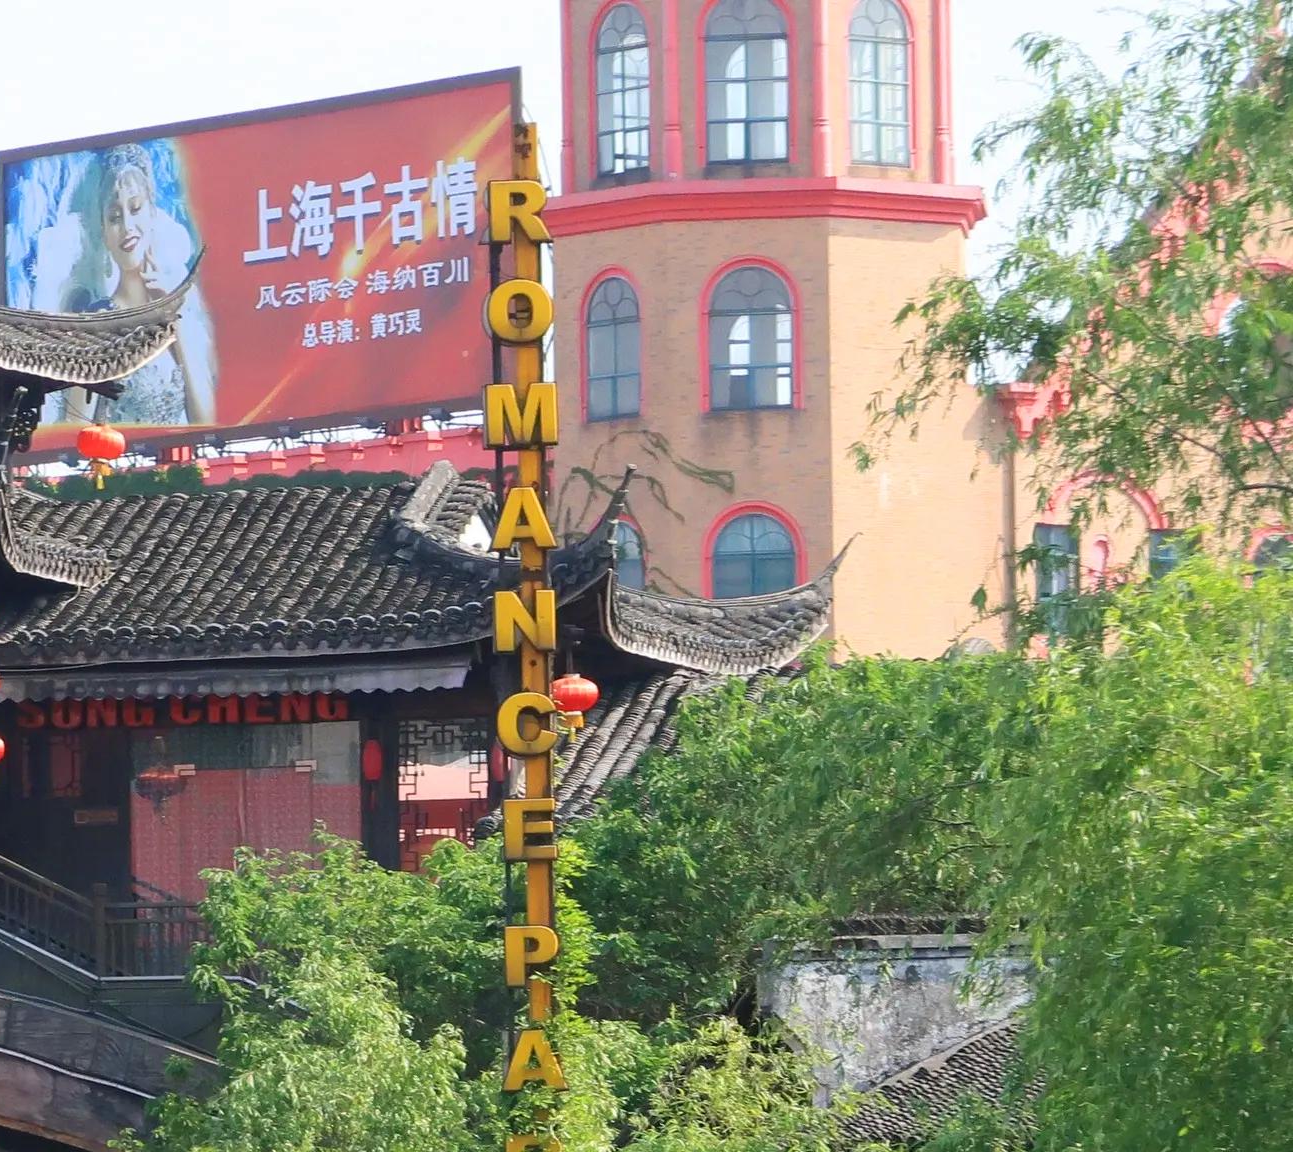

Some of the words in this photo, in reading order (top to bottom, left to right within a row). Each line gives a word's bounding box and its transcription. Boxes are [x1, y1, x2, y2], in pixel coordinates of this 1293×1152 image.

[243, 157, 477, 264] 上海千古情
[255, 276, 359, 310] 风云际会
[365, 256, 469, 295] 海纳百川
[484, 180, 559, 862] ROMANCE
